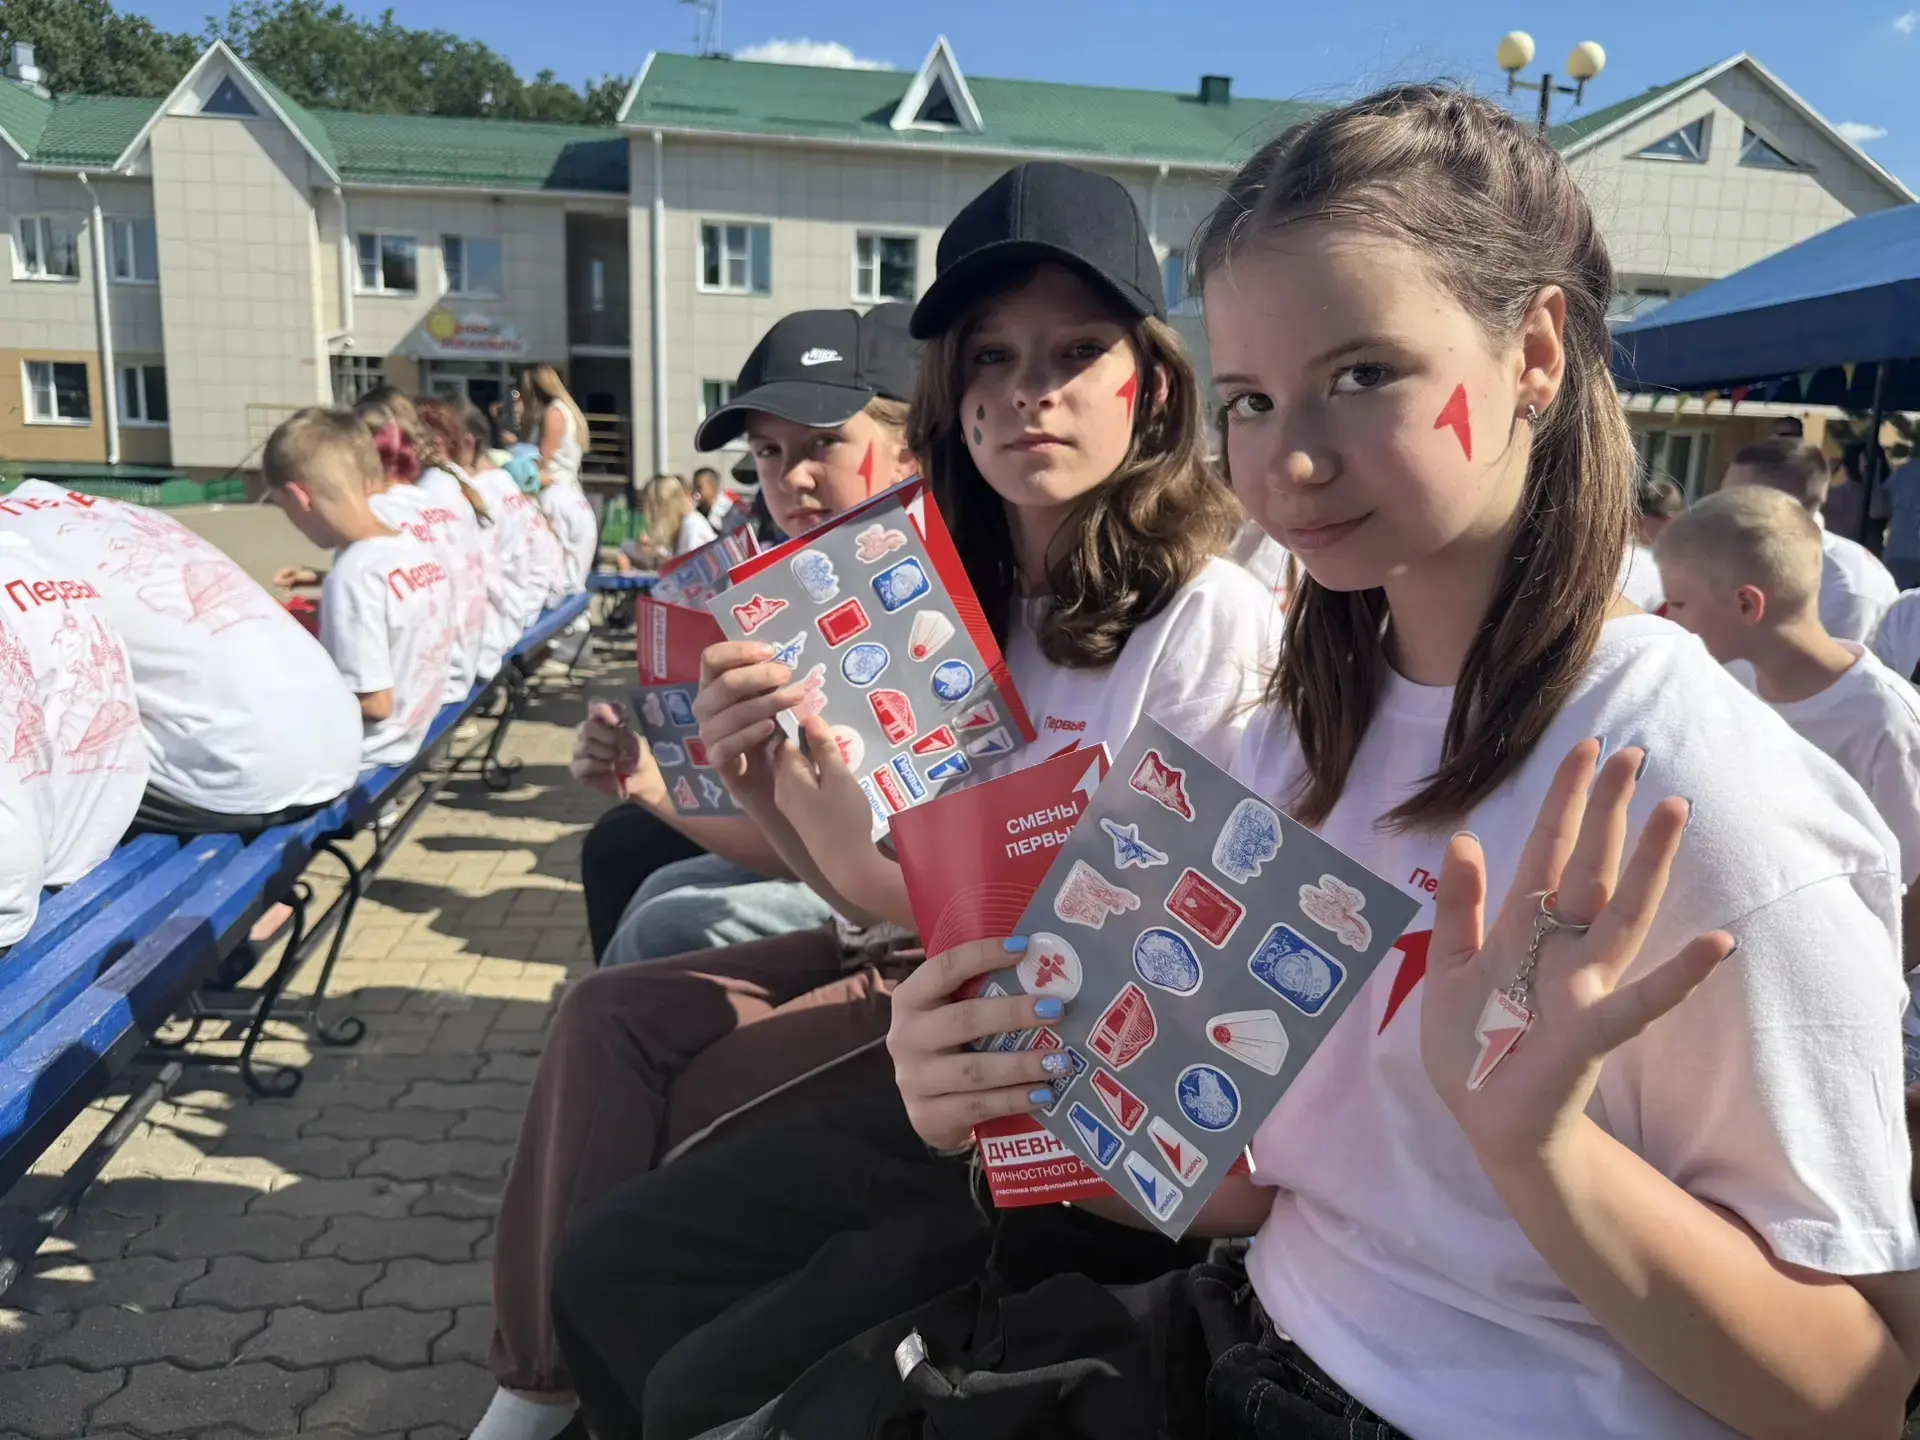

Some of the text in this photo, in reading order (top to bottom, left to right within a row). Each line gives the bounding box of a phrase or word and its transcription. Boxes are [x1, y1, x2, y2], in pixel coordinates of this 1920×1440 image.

[4, 578, 102, 612] Первы
[1044, 715, 1087, 733] Первые
[881, 767, 907, 810] Первые
[896, 754, 925, 798] Первые
[1006, 800, 1079, 834] СМЕНЫ
[1005, 824, 1075, 859] ПЕРВЫ
[987, 1135, 1069, 1163] ДНЕВН
[991, 1161, 1078, 1183] ЛИЧНОСТНОГО
[995, 1188, 1029, 1197] участника
[1029, 1179, 1079, 1193] профильной
